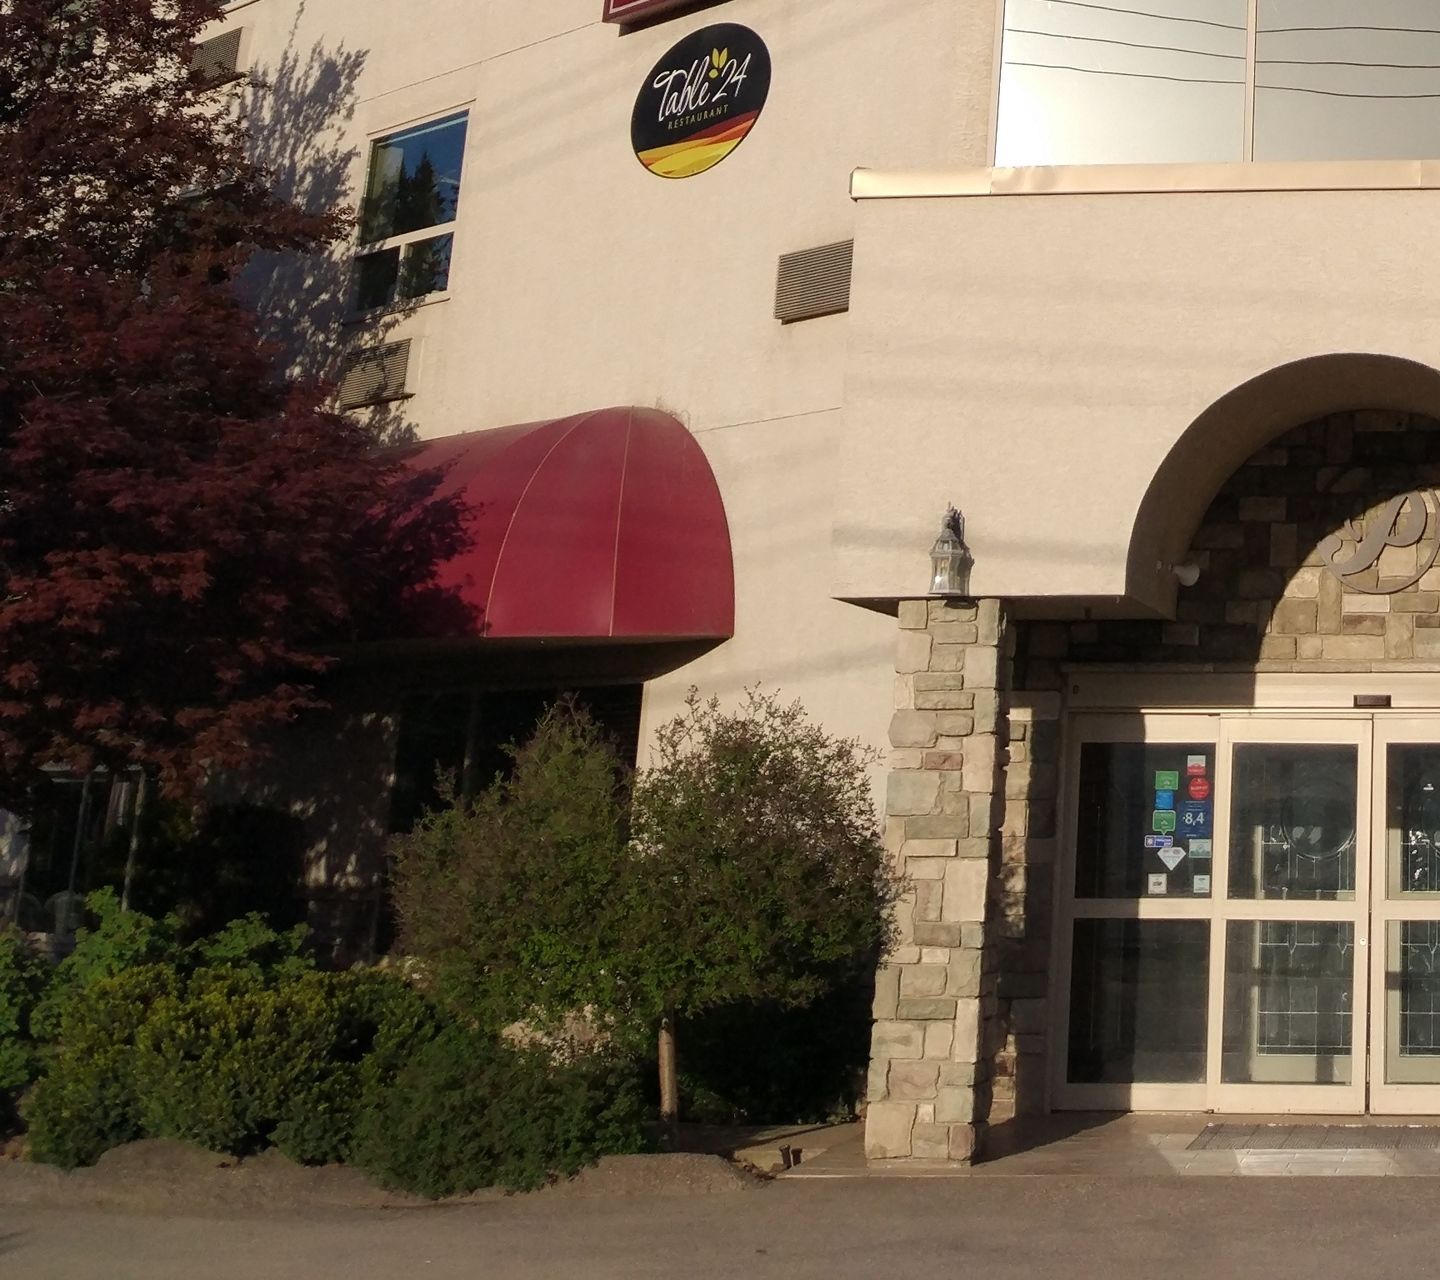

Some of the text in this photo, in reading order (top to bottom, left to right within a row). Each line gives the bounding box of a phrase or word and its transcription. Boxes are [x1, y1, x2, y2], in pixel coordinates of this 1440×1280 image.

[653, 53, 752, 122] Table 24
[667, 104, 729, 130] RESTAURANT
